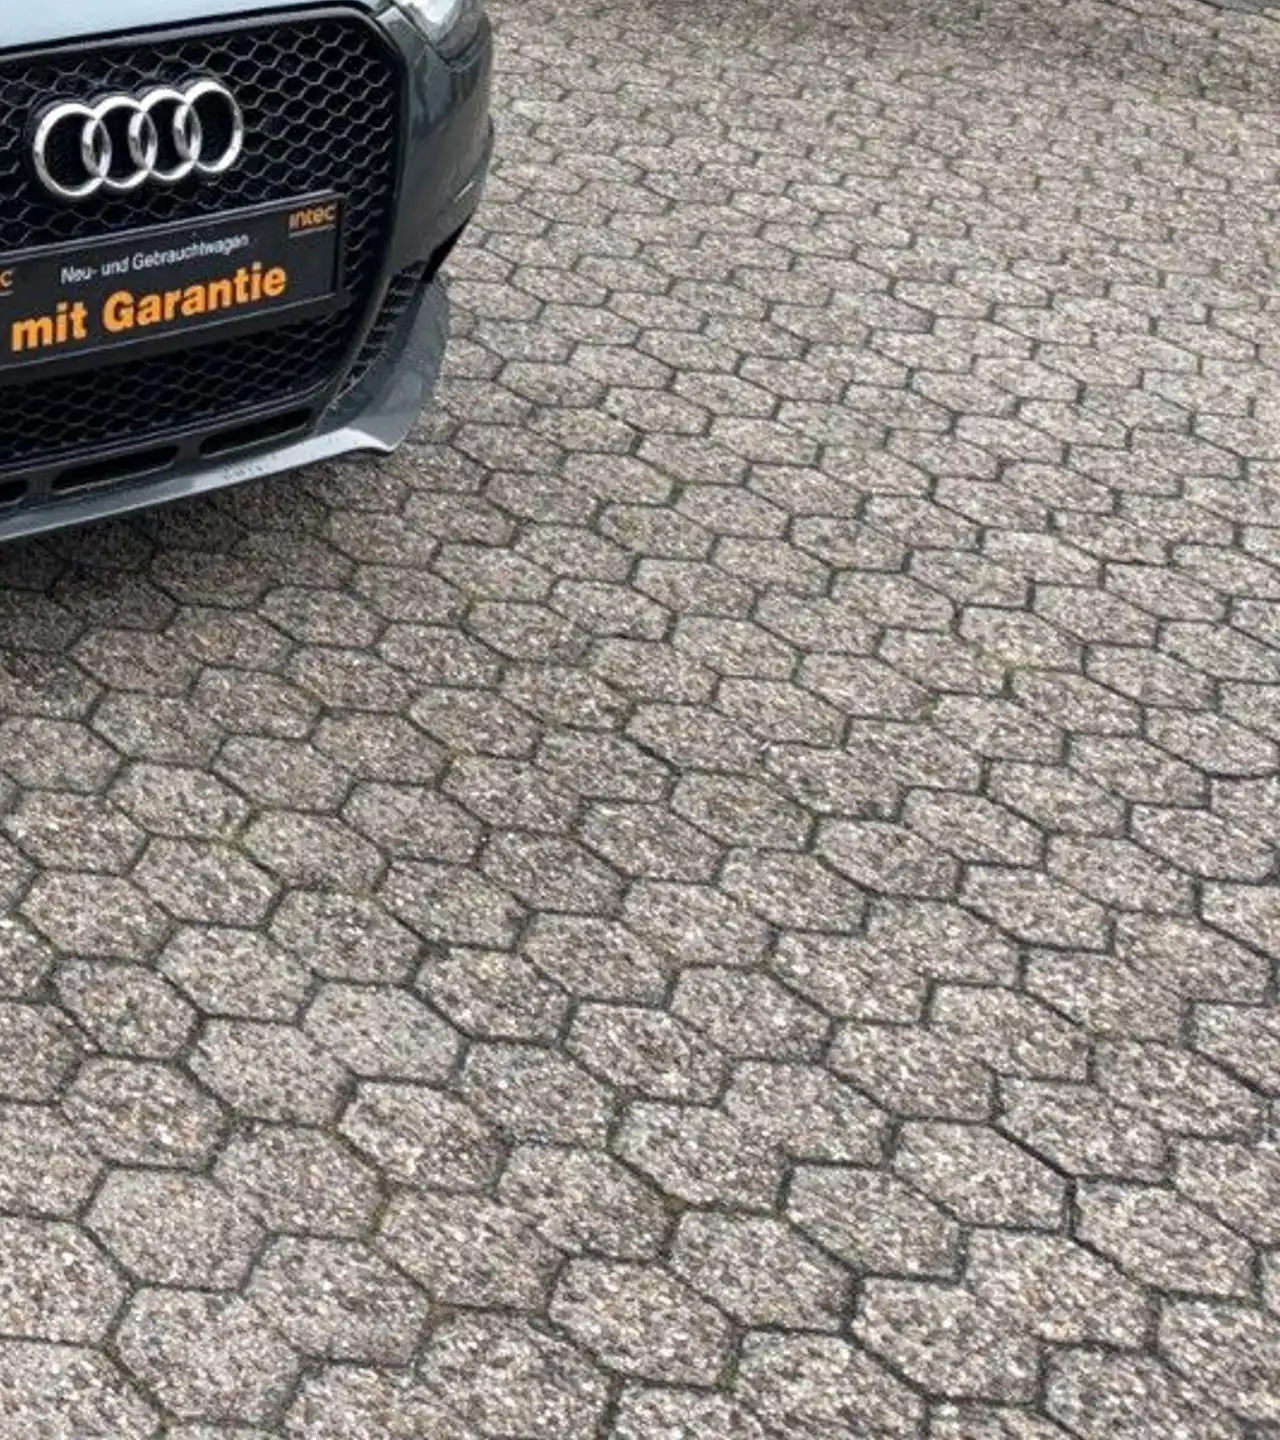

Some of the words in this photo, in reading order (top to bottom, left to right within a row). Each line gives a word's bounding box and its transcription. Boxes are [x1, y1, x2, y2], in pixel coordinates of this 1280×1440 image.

[288, 203, 338, 230] intec
[60, 266, 97, 285] Neu-
[101, 256, 129, 276] und
[132, 233, 250, 270] Gebrauchtwagen
[10, 301, 88, 353] mit
[102, 261, 288, 333] Garantie
